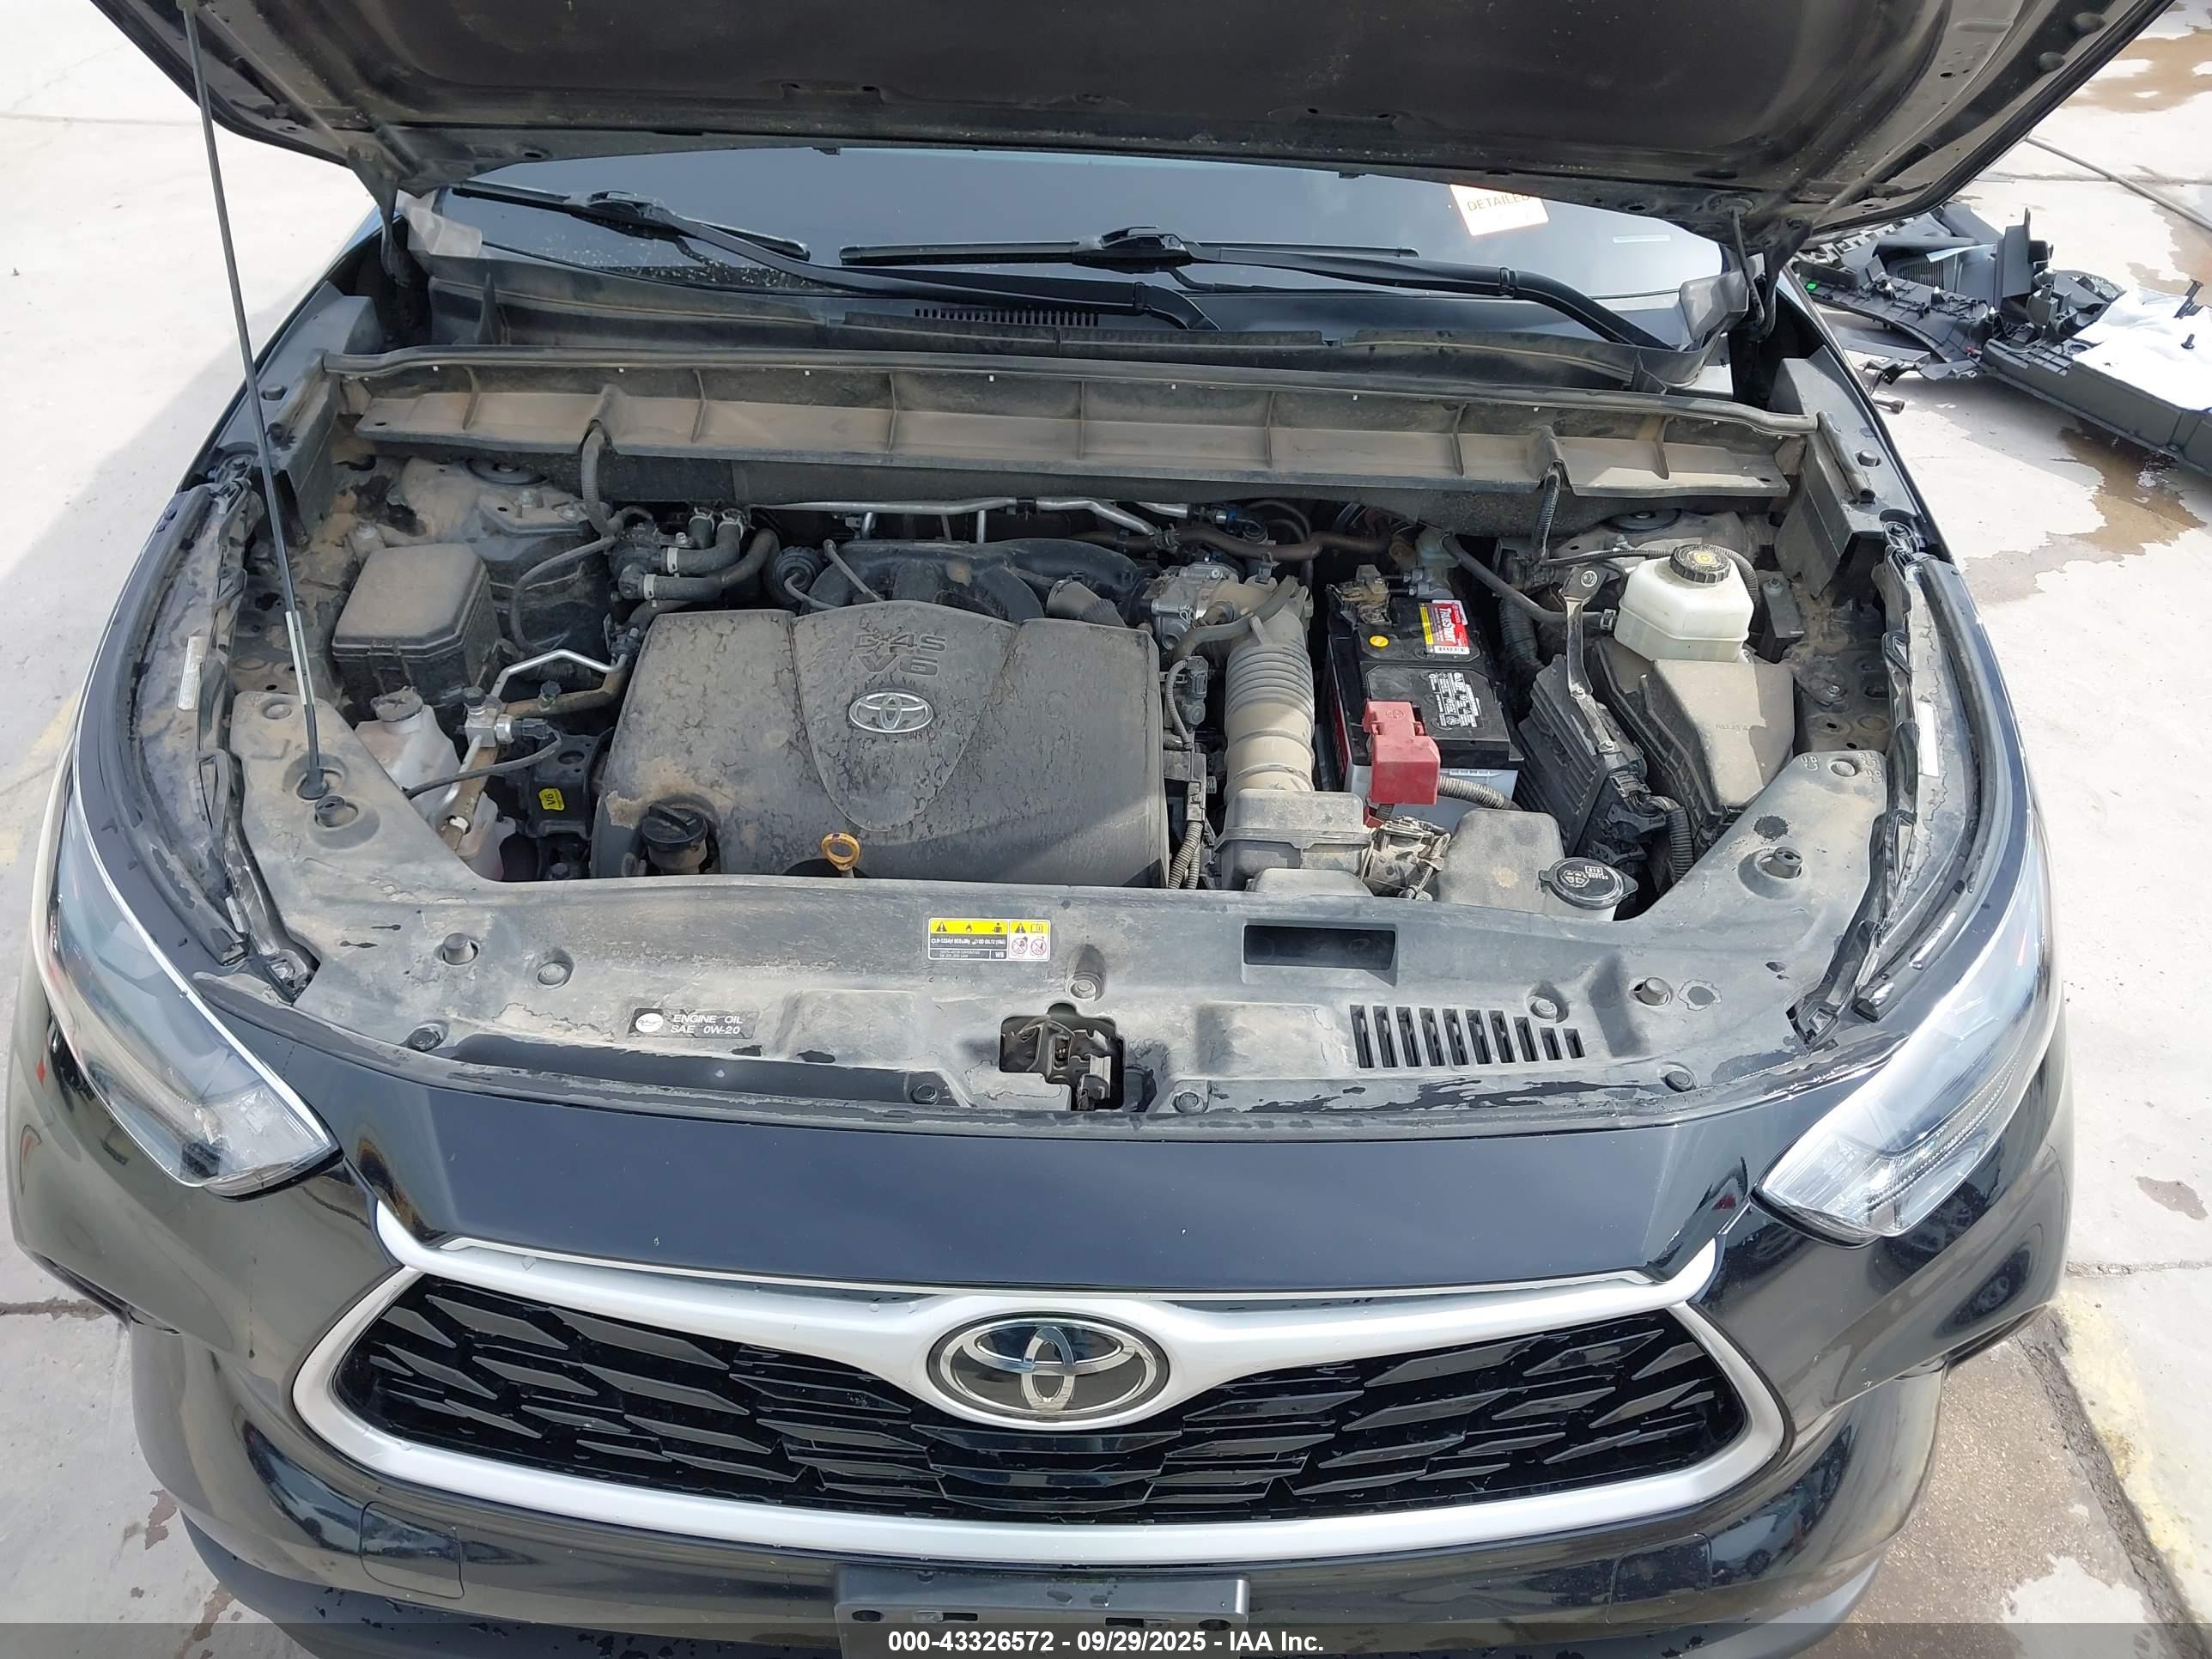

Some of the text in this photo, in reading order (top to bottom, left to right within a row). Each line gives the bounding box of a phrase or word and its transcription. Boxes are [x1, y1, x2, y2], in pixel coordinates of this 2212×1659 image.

[1467, 194, 1529, 211] DETAILED
[857, 653, 939, 677] V6
[544, 793, 556, 805] V6
[673, 1014, 744, 1024] ENGINE OIL
[670, 1024, 740, 1034] SAE 0W-20
